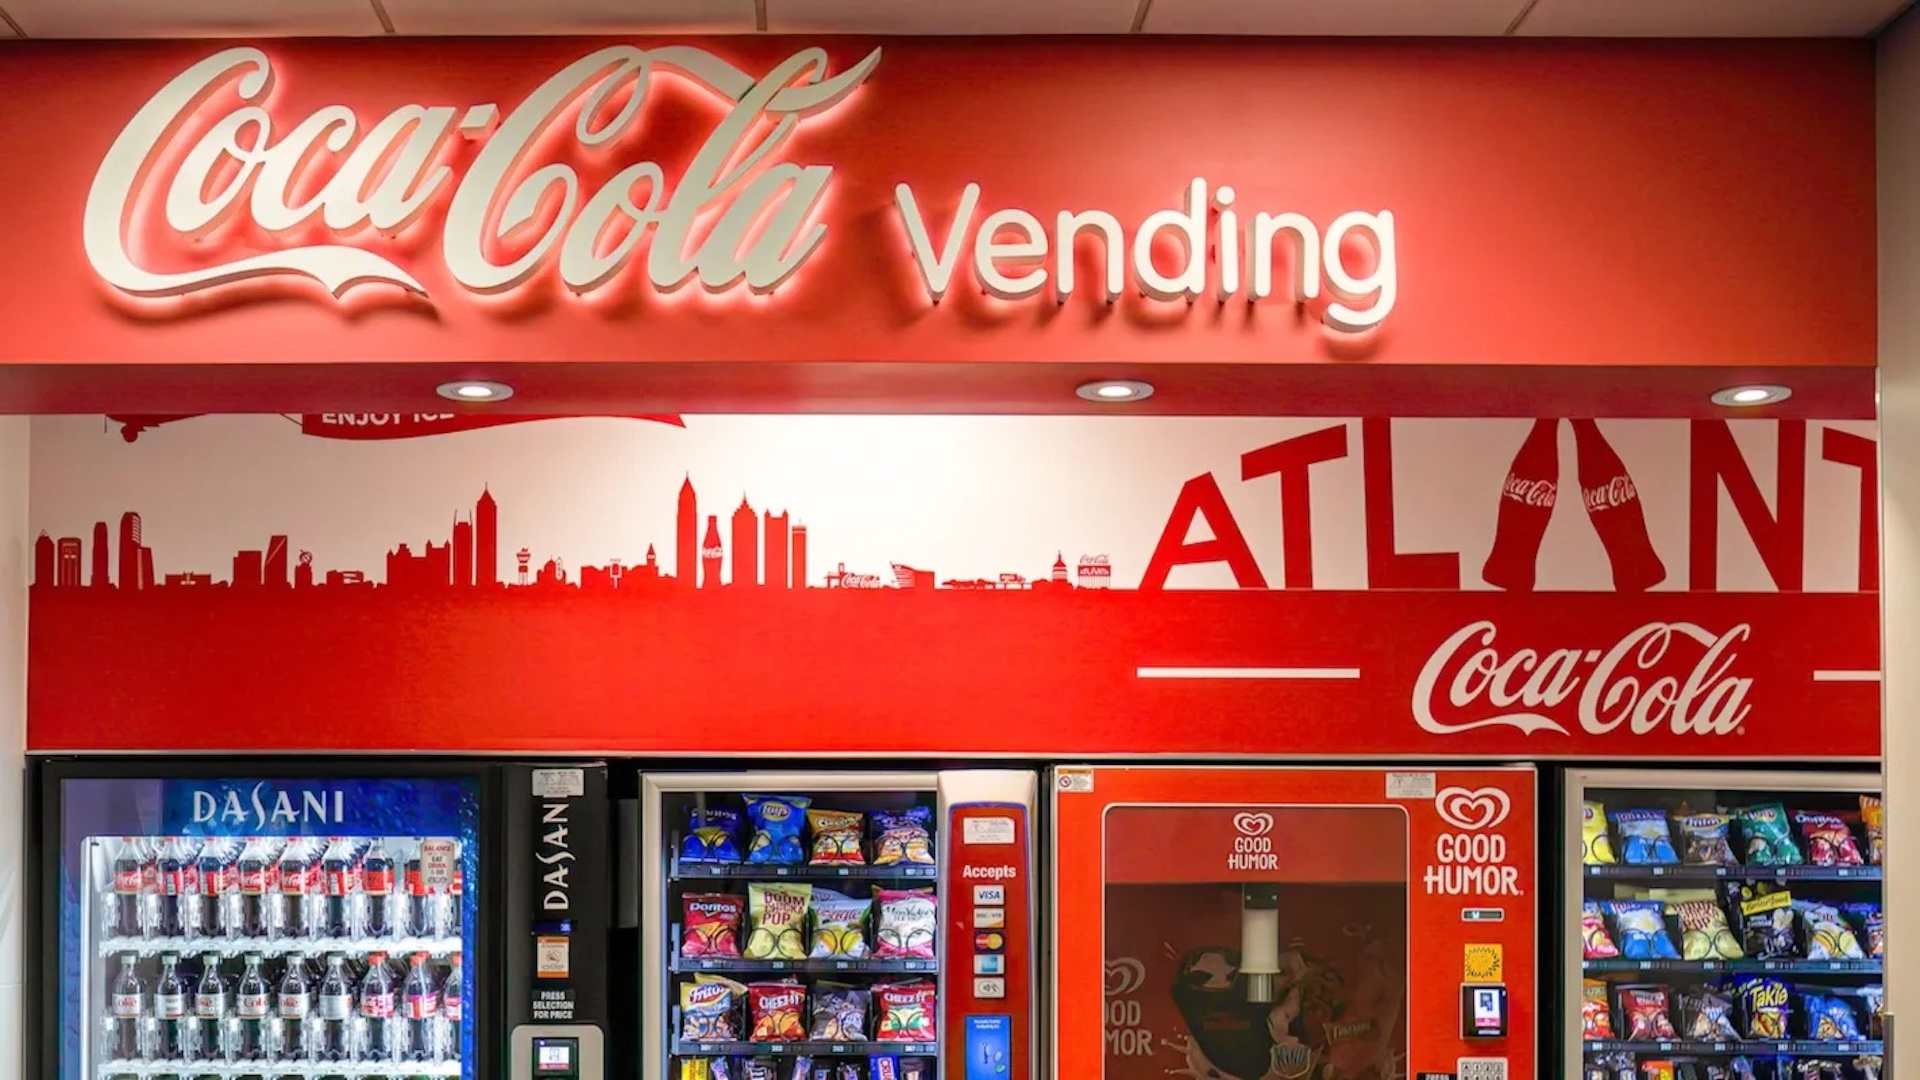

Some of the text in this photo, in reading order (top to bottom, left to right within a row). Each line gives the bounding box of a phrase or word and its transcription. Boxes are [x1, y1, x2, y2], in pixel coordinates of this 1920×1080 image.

[84, 46, 1397, 333] Coca-Cola Vending
[1411, 620, 1752, 736] Coca-Cola
[193, 781, 344, 831] DASANI
[1234, 837, 1272, 853] GOOD
[1437, 833, 1506, 864] GOOD
[1227, 853, 1279, 870] HUMOR
[962, 864, 1016, 881] Accepts
[764, 891, 805, 906] BOOM
[979, 891, 1001, 899] VISA
[690, 902, 737, 913] Doritos
[762, 912, 791, 925] POP
[541, 991, 565, 1000] PRESS
[533, 1001, 574, 1010] SELECTION
[1105, 1000, 1141, 1027] OD
[534, 1010, 573, 1019] FOR PRICE
[1105, 1028, 1153, 1056] MOR
